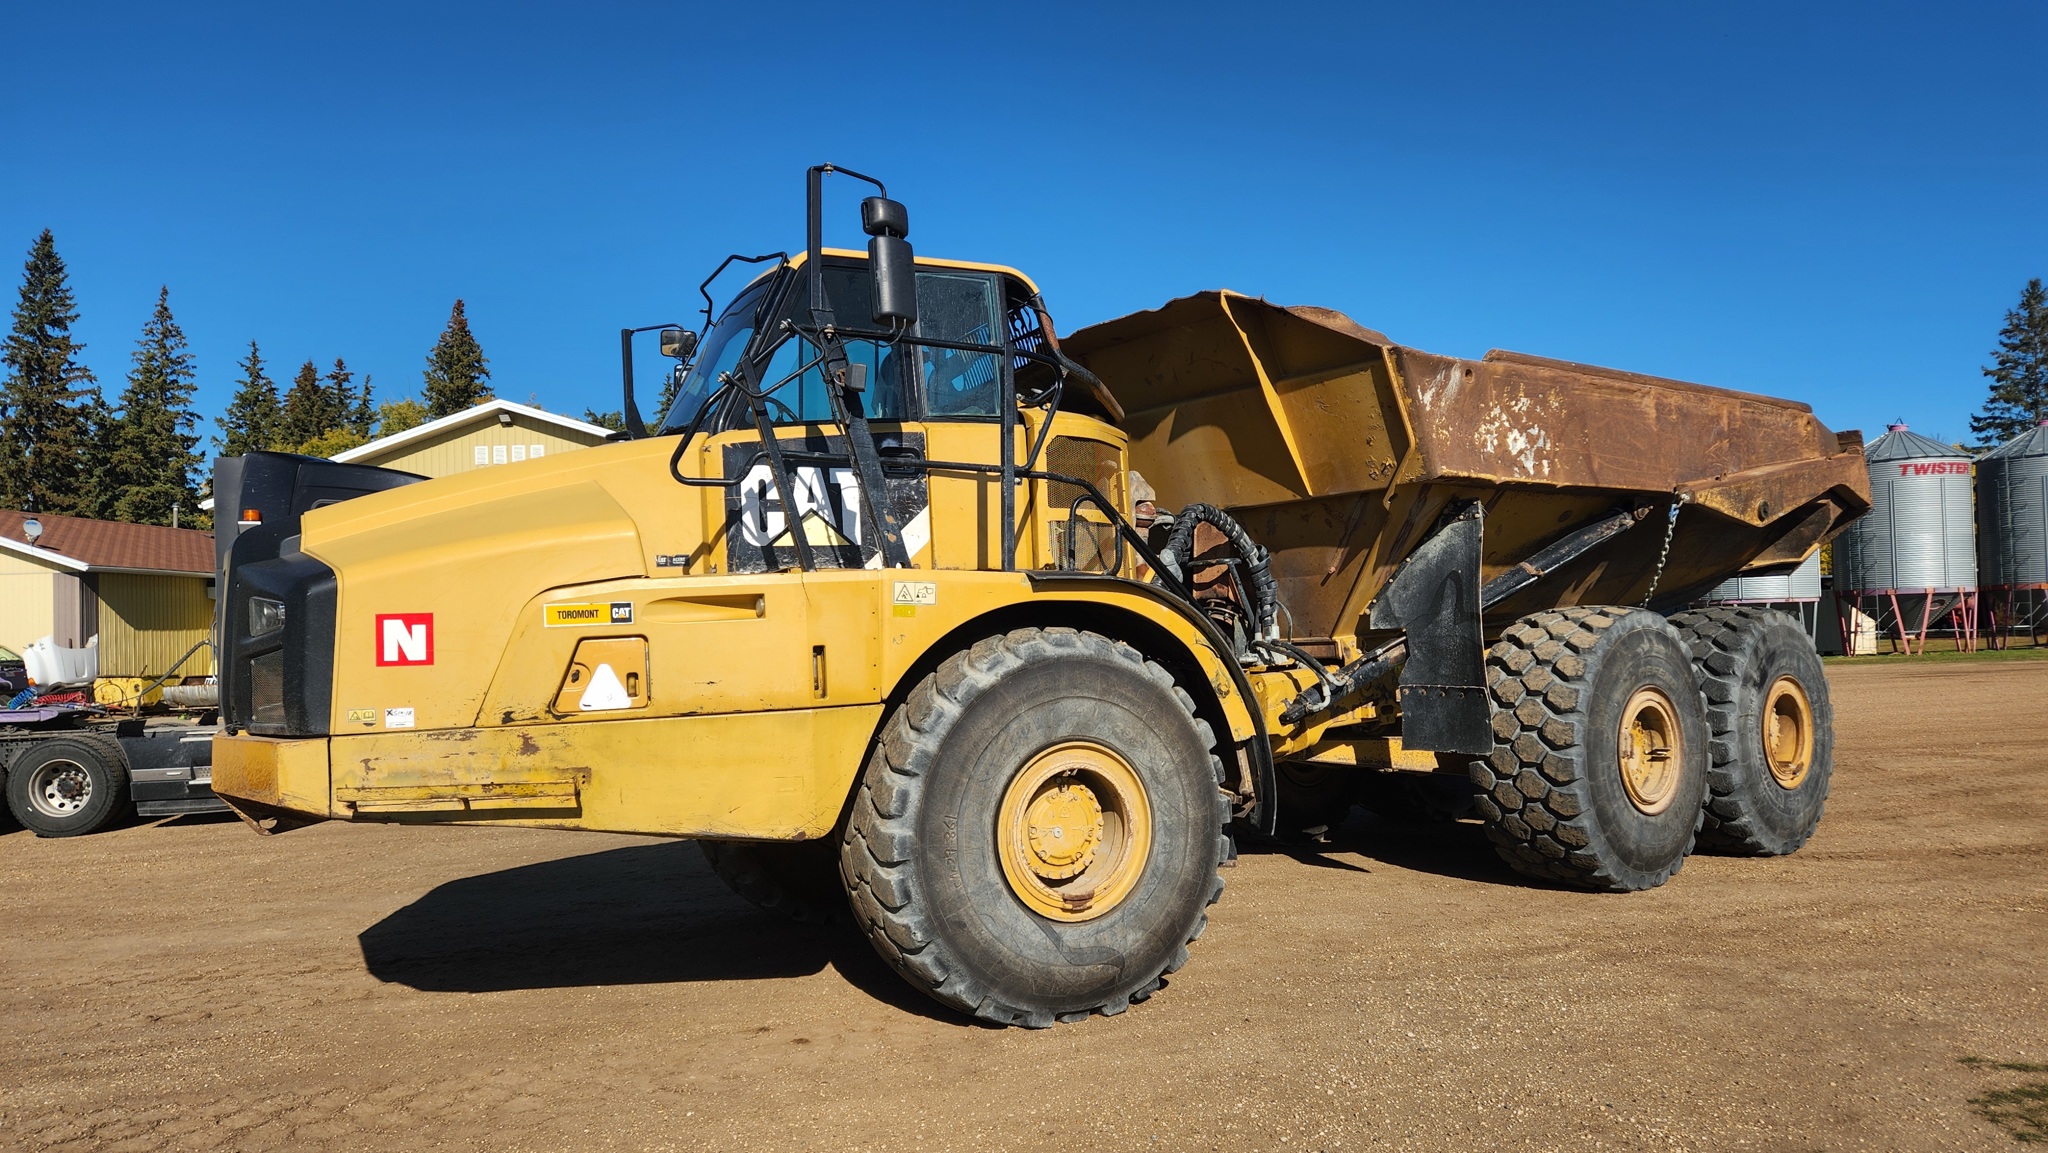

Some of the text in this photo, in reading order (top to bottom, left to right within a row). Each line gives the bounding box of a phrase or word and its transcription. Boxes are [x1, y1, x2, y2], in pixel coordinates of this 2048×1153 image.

[1898, 462, 1971, 476] TWISTER
[741, 464, 862, 546] CAT
[557, 609, 599, 619] TOROMONT
[612, 607, 631, 619] CAT
[383, 619, 426, 662] N
